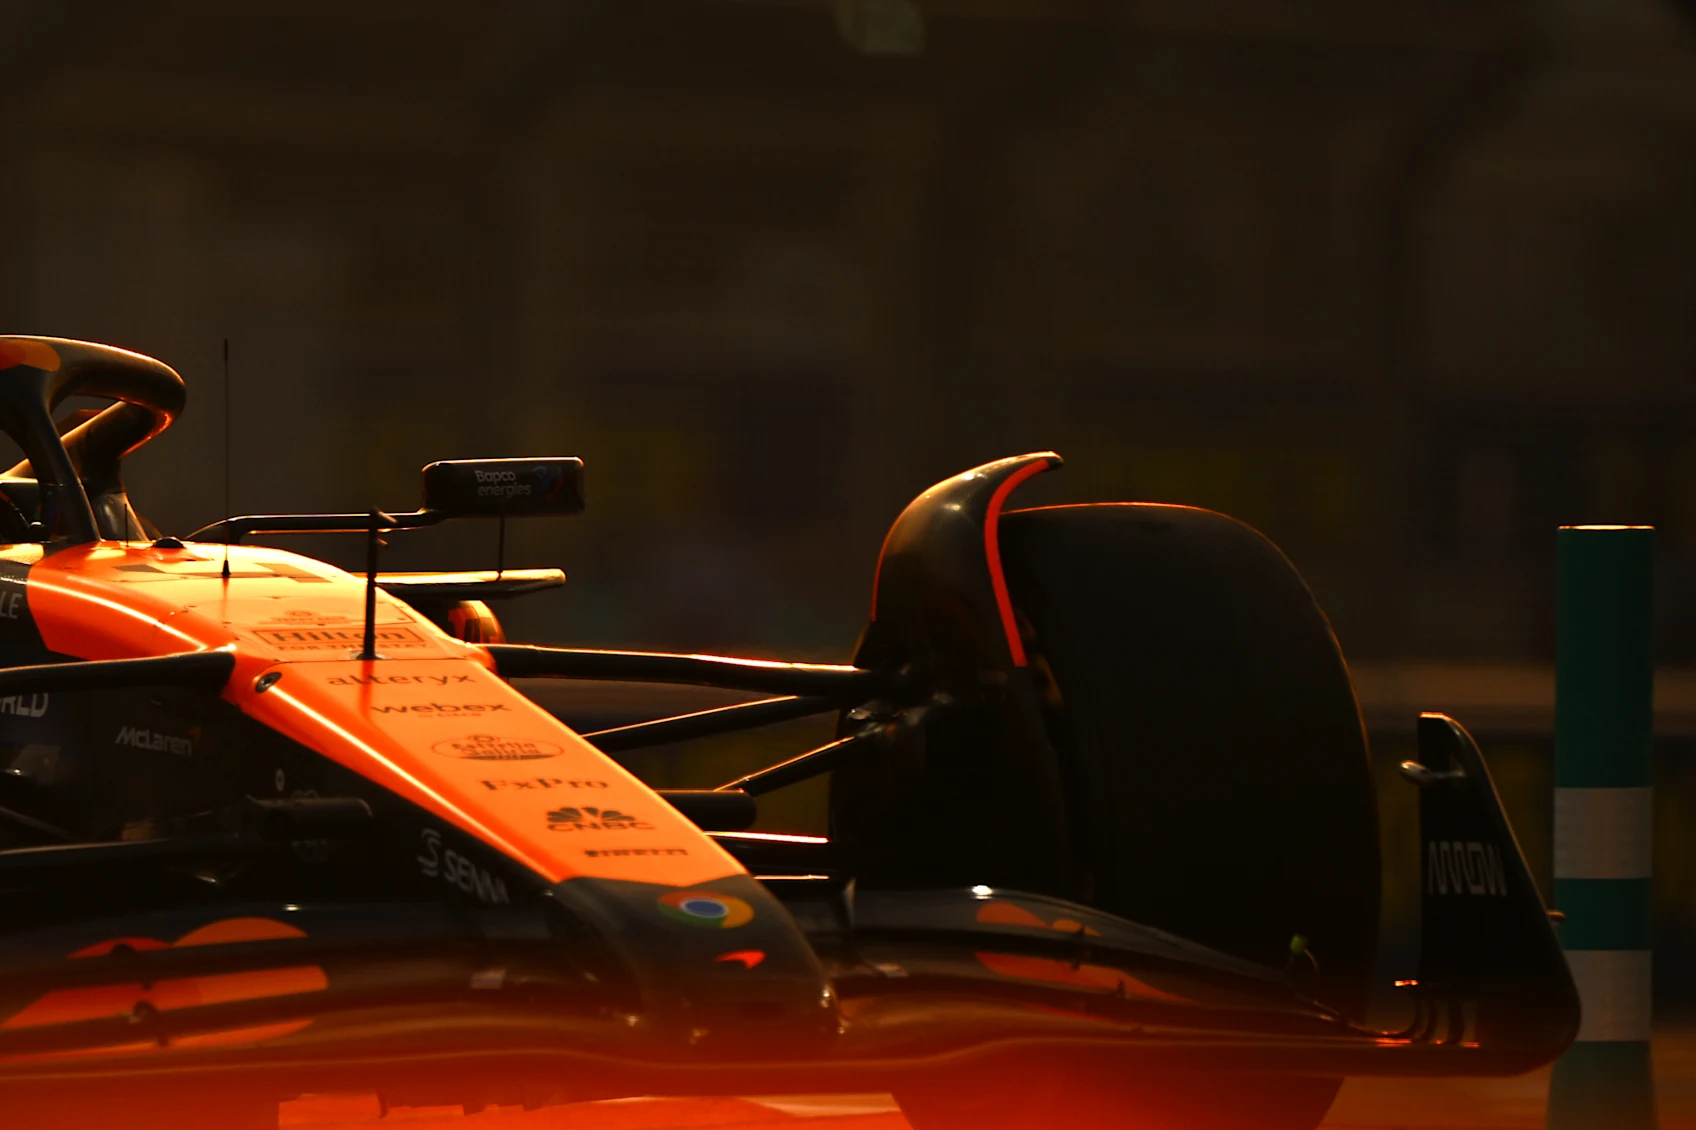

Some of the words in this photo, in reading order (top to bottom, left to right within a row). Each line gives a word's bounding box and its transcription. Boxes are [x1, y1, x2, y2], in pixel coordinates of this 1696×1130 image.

[475, 469, 517, 485] Bapco
[478, 482, 532, 499] energies
[326, 674, 477, 686] alteryx
[371, 703, 512, 714] webex
[115, 725, 193, 758] McLaren
[481, 777, 610, 791] FxPro
[547, 821, 656, 832] CNBC
